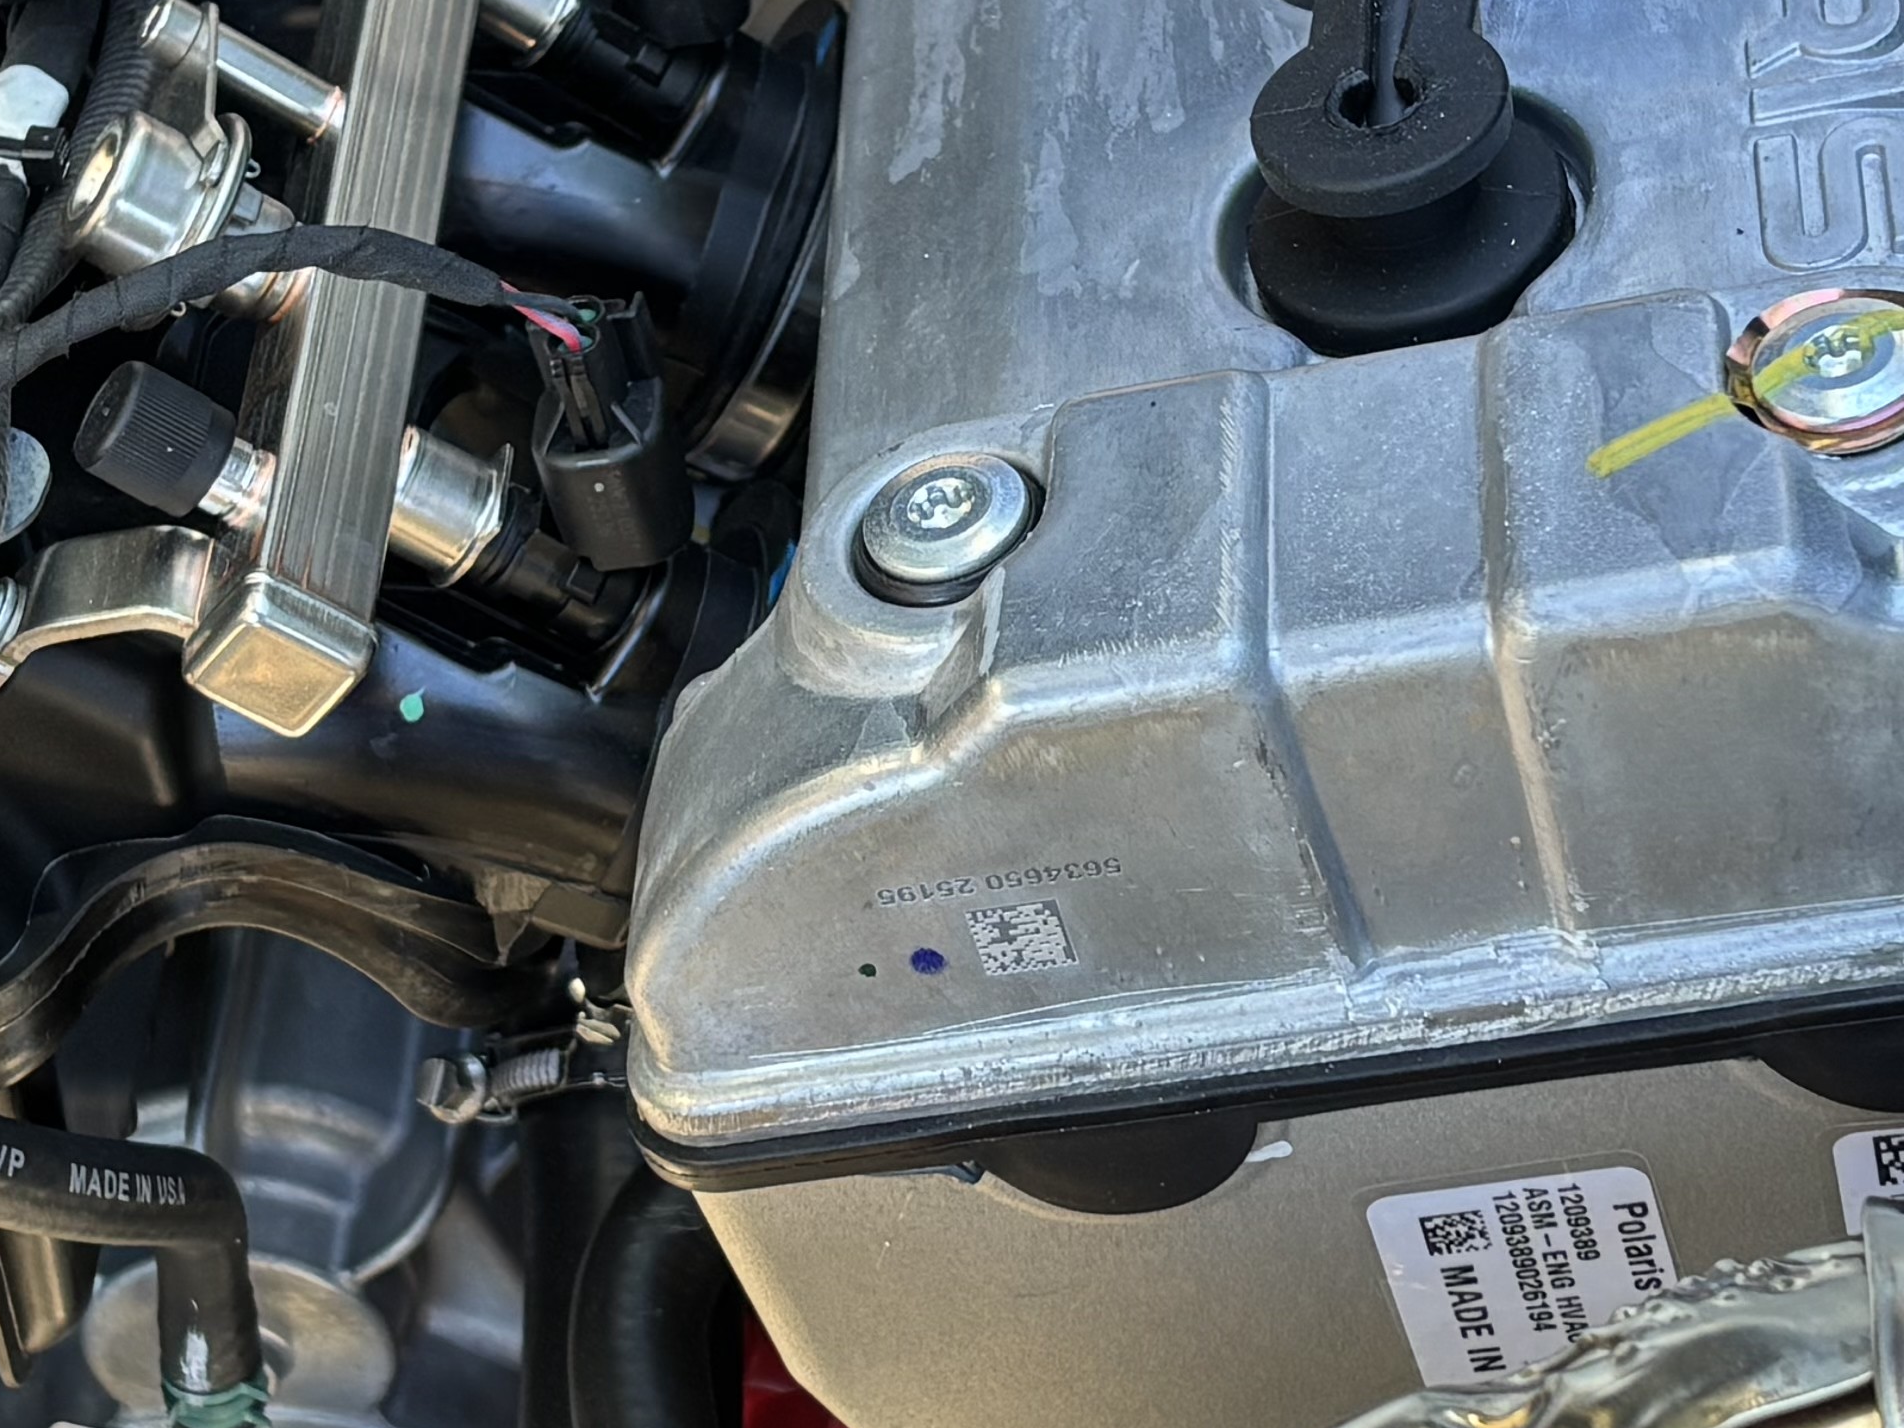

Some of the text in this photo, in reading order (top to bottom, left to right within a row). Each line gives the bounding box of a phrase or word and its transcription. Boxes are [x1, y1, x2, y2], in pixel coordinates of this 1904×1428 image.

[876, 856, 1123, 907] 5634650 25195
[68, 1162, 187, 1206] MADE IN USA
[1557, 1182, 1602, 1262] 1209389
[1491, 1190, 1558, 1333] 1209389026194
[1522, 1187, 1559, 1230] ASM
[1541, 1250, 1576, 1291] ENG
[1612, 1200, 1666, 1293] Polaris
[1440, 1264, 1507, 1373] MADE IN
